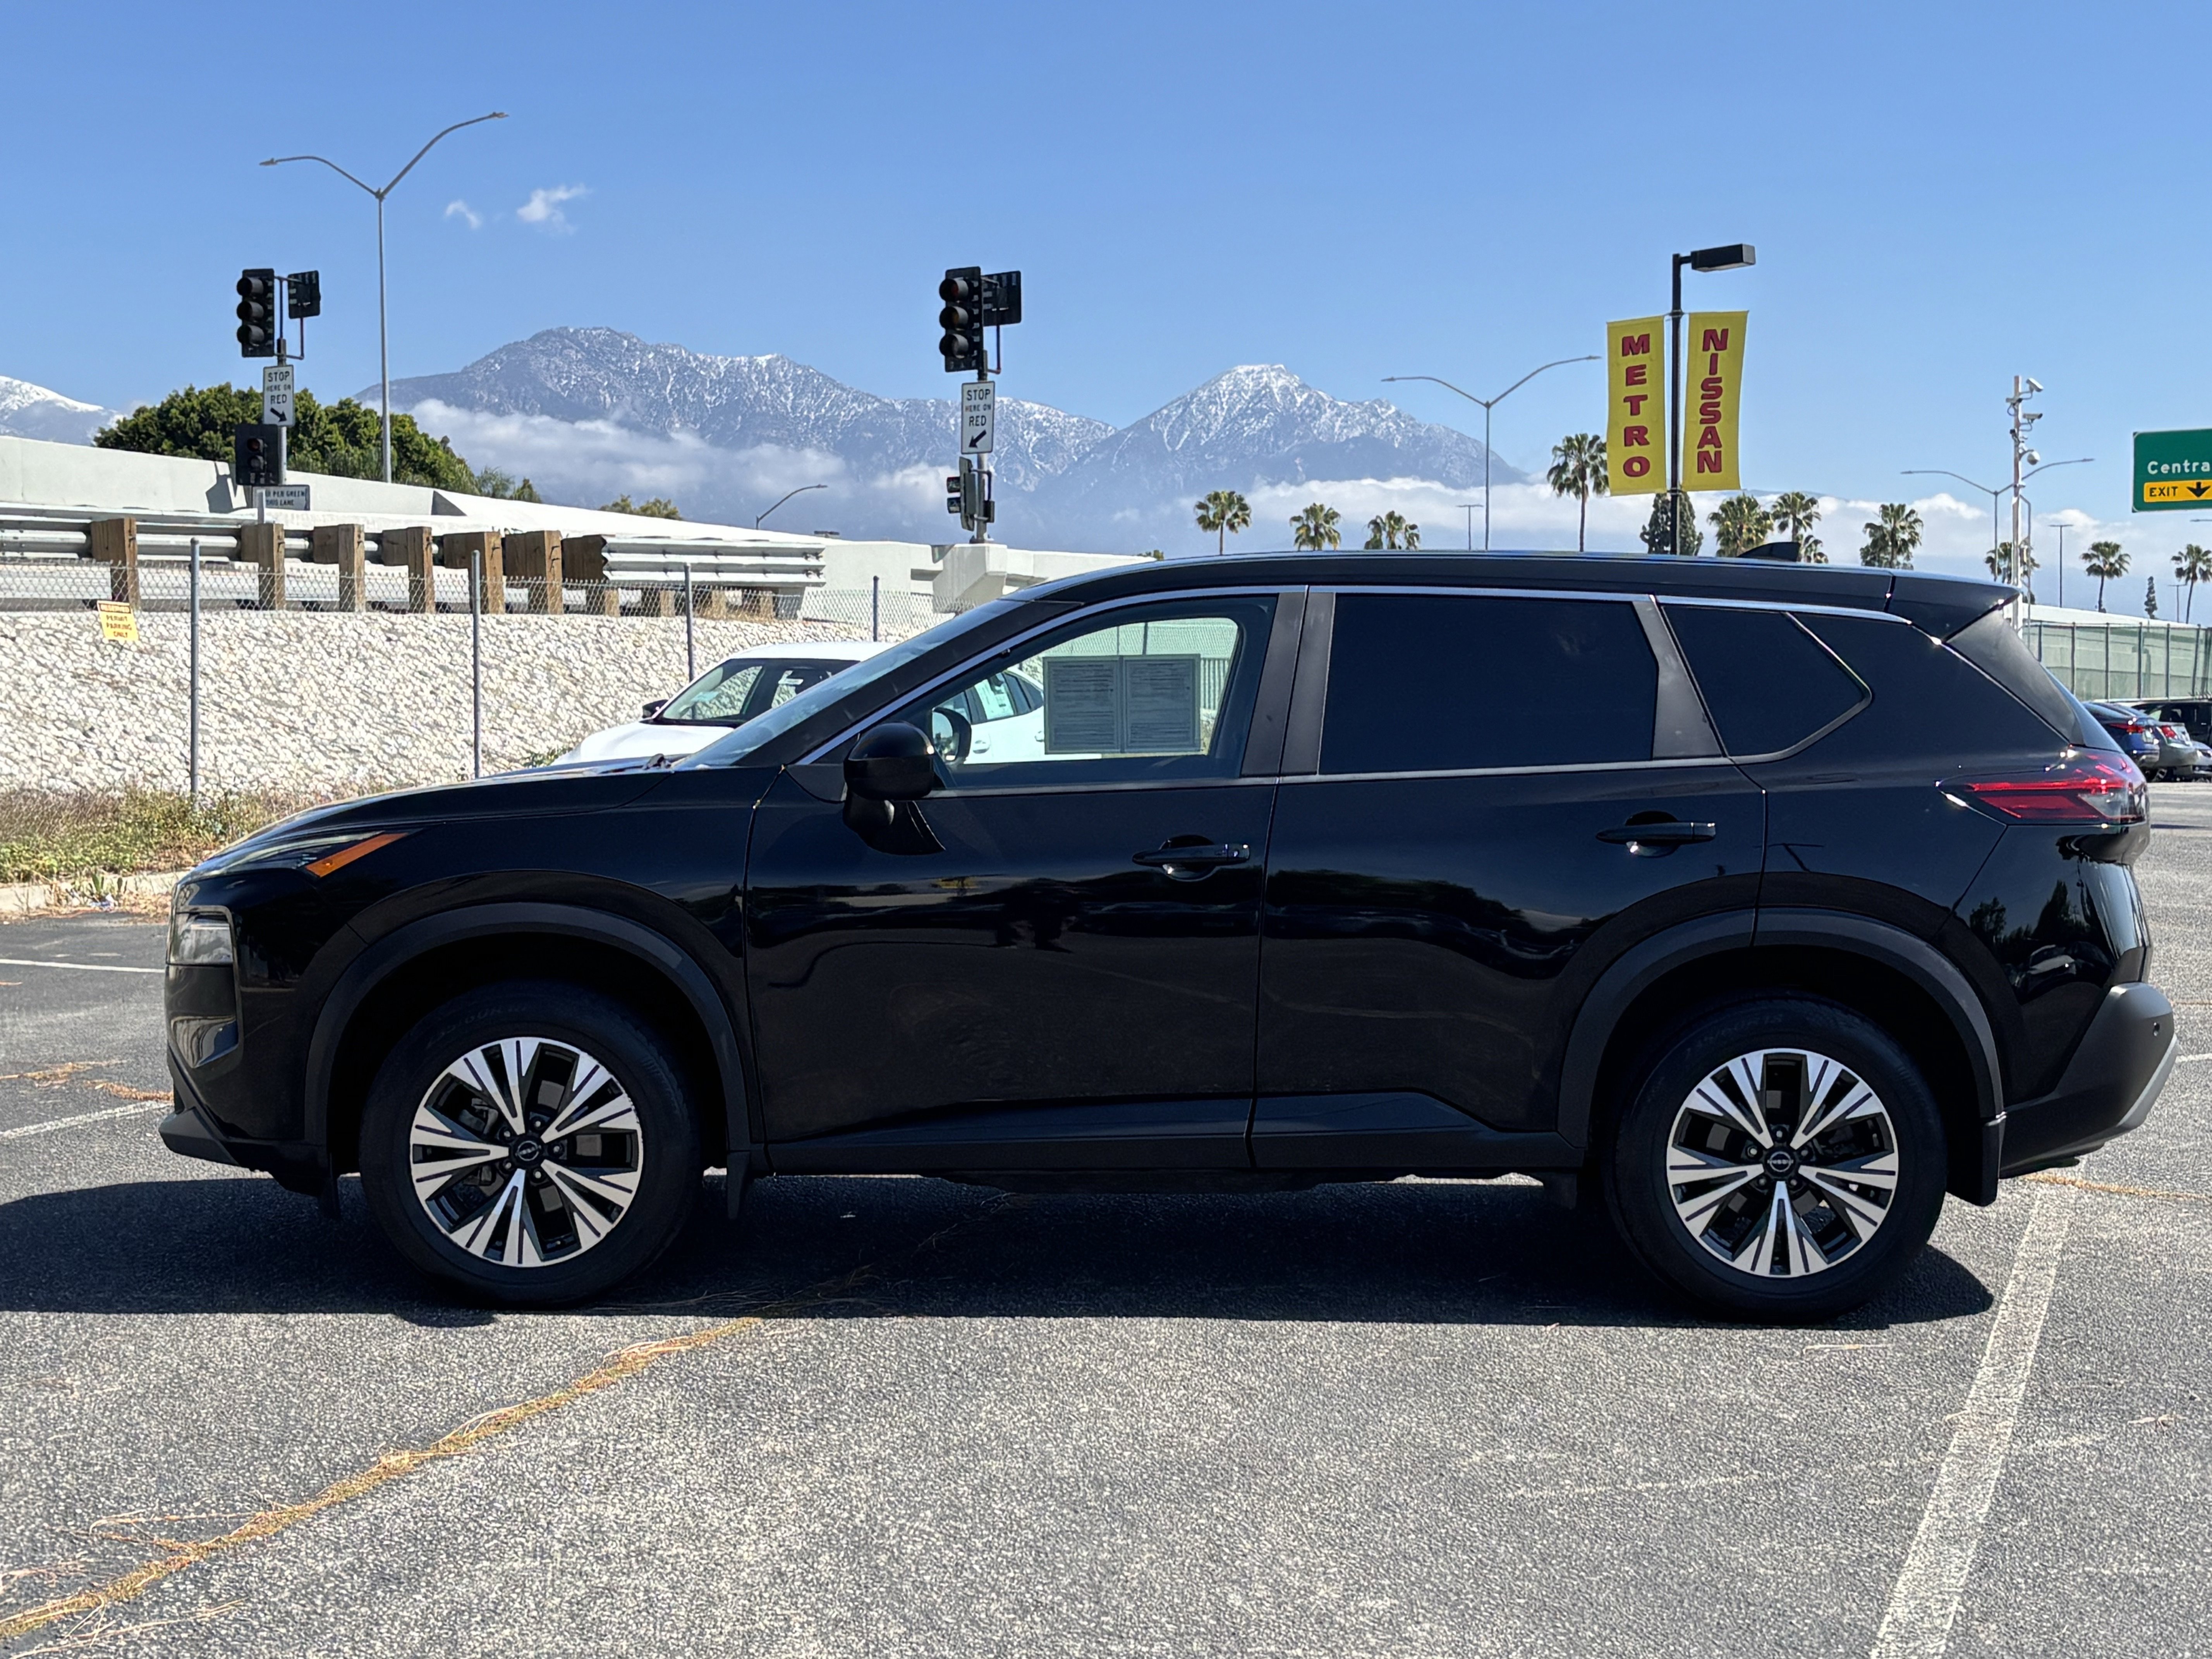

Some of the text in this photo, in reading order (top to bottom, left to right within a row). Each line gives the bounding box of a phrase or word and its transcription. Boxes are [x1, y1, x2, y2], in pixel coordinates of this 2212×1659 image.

[268, 371, 290, 382] STOP
[271, 394, 287, 404] RED
[967, 389, 990, 400] STOP
[1622, 333, 1650, 477] METRO
[1697, 328, 1729, 473] NISSAN
[969, 415, 986, 426] RED
[2149, 486, 2178, 497] EXIT
[106, 622, 132, 630] PARKING
